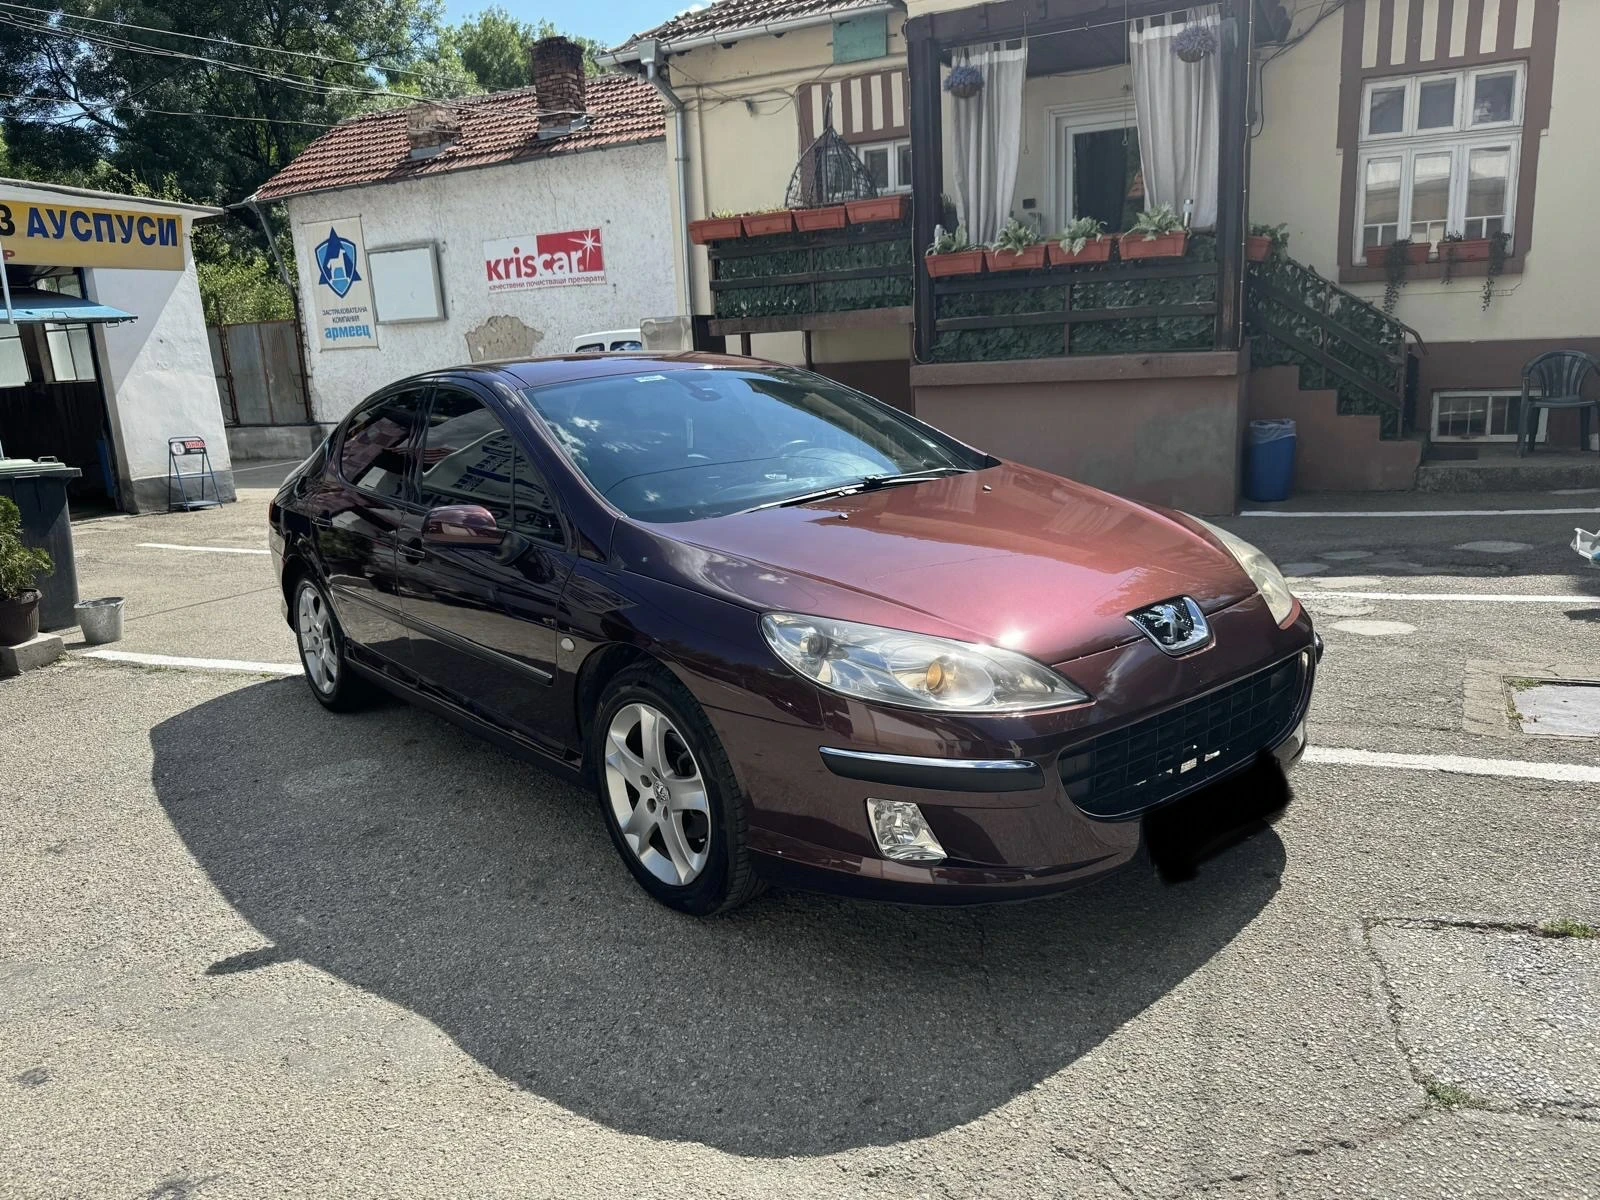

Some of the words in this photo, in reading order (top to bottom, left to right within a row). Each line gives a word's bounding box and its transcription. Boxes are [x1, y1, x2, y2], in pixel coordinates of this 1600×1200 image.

[27, 207, 177, 246] АУСПУСИ
[568, 275, 605, 284] препарати
[325, 325, 371, 340] армеец
